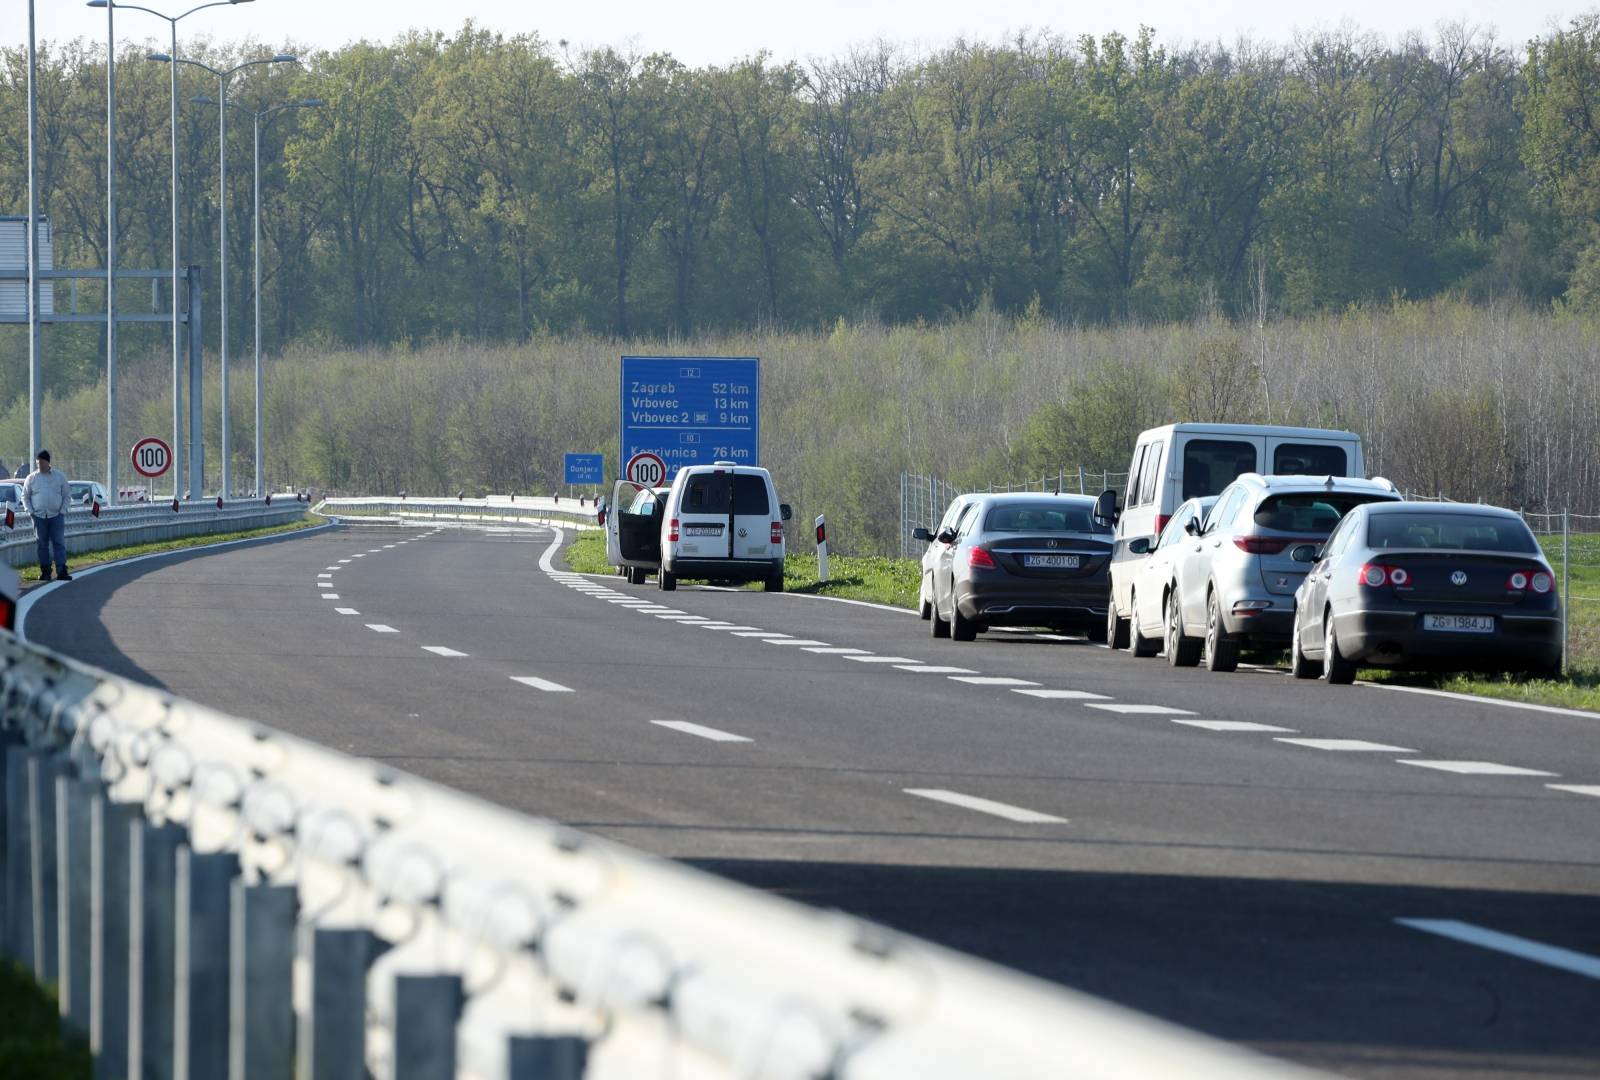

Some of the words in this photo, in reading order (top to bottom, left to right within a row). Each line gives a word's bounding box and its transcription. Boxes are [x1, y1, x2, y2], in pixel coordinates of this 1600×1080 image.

[687, 369, 694, 377] 12
[631, 382, 675, 395] Zagreb
[712, 383, 727, 394] 52
[730, 382, 749, 394] km
[631, 397, 679, 408] Vrbovec
[715, 398, 727, 409] 13
[730, 398, 749, 409] km
[631, 411, 677, 423] Vrbovec
[681, 412, 689, 423] 2
[720, 412, 727, 423] 9
[730, 412, 749, 424] km
[140, 448, 164, 467] 100
[712, 447, 727, 458] 76
[730, 446, 749, 458] km
[635, 463, 659, 483] 100
[1432, 615, 1445, 628] ZG
